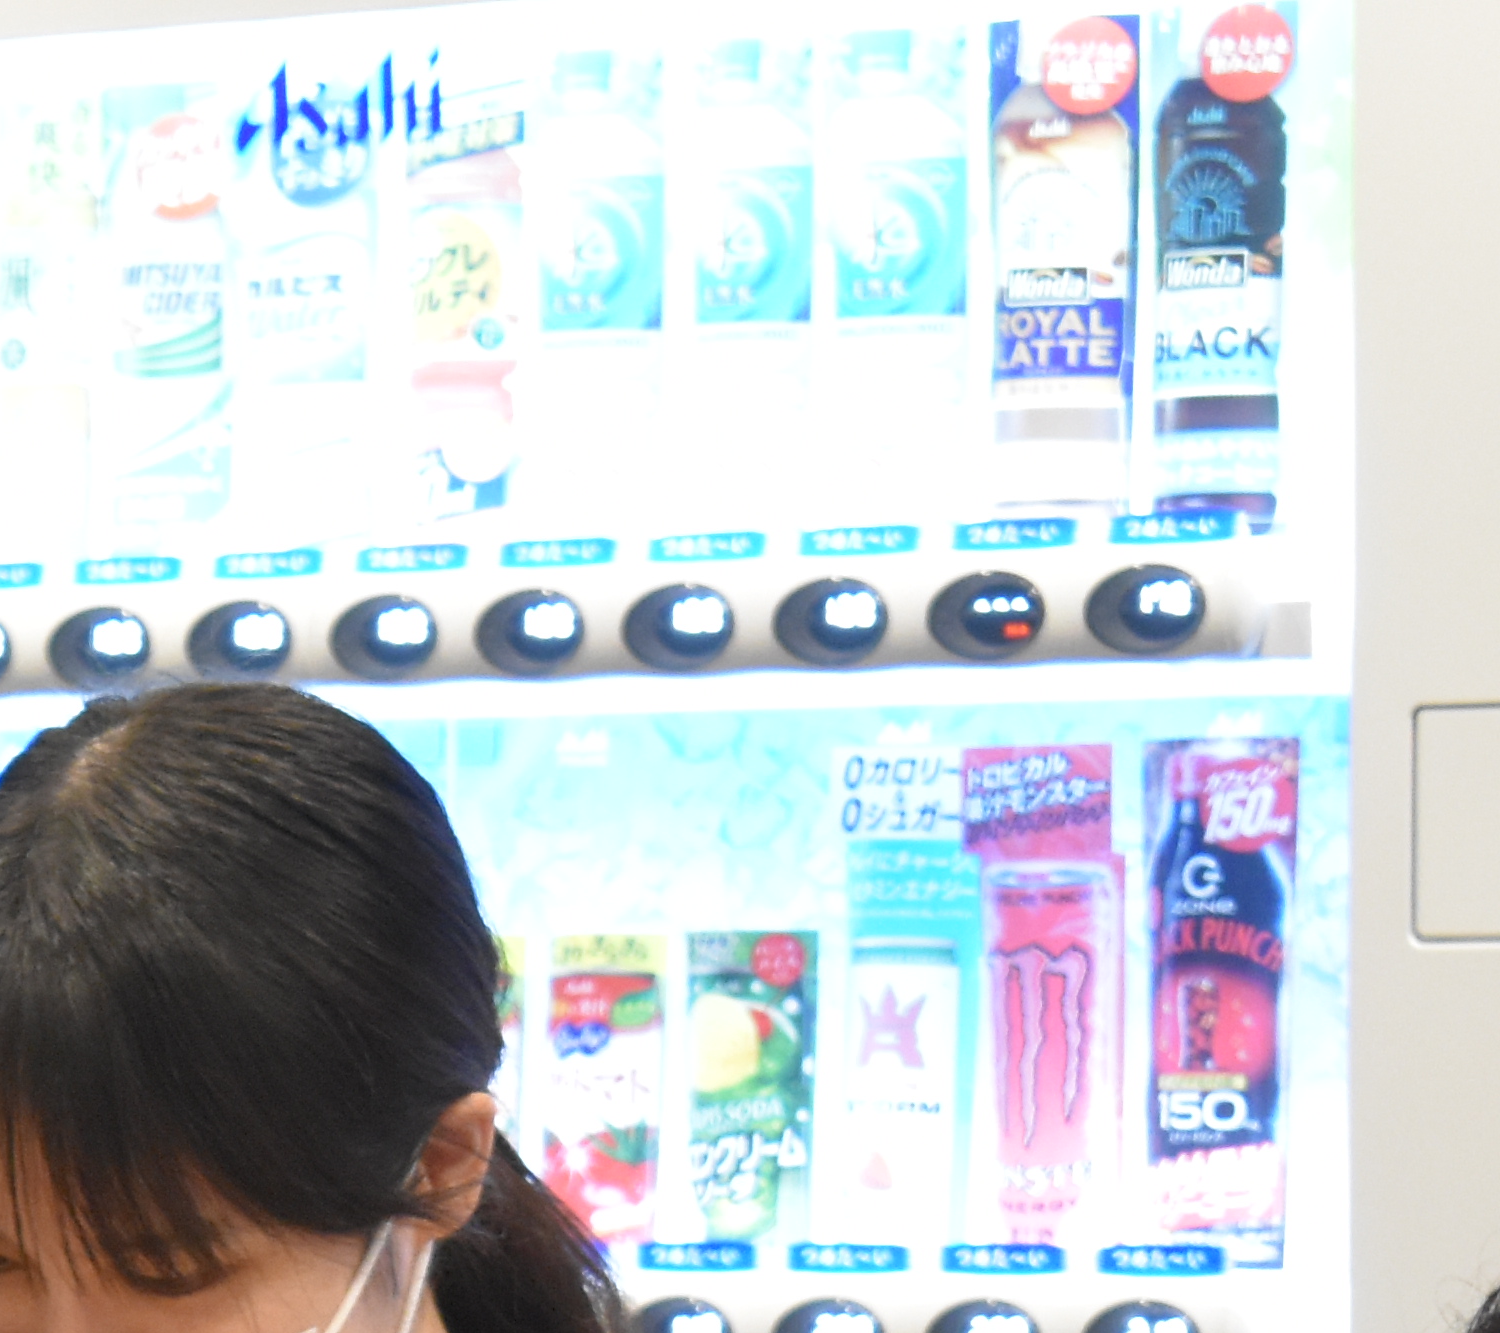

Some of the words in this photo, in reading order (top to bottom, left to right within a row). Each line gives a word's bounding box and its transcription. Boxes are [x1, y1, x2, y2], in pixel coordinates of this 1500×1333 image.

[1007, 267, 1085, 299] Wonda
[1166, 257, 1242, 289] Wonda
[1155, 326, 1272, 364] BLACK
